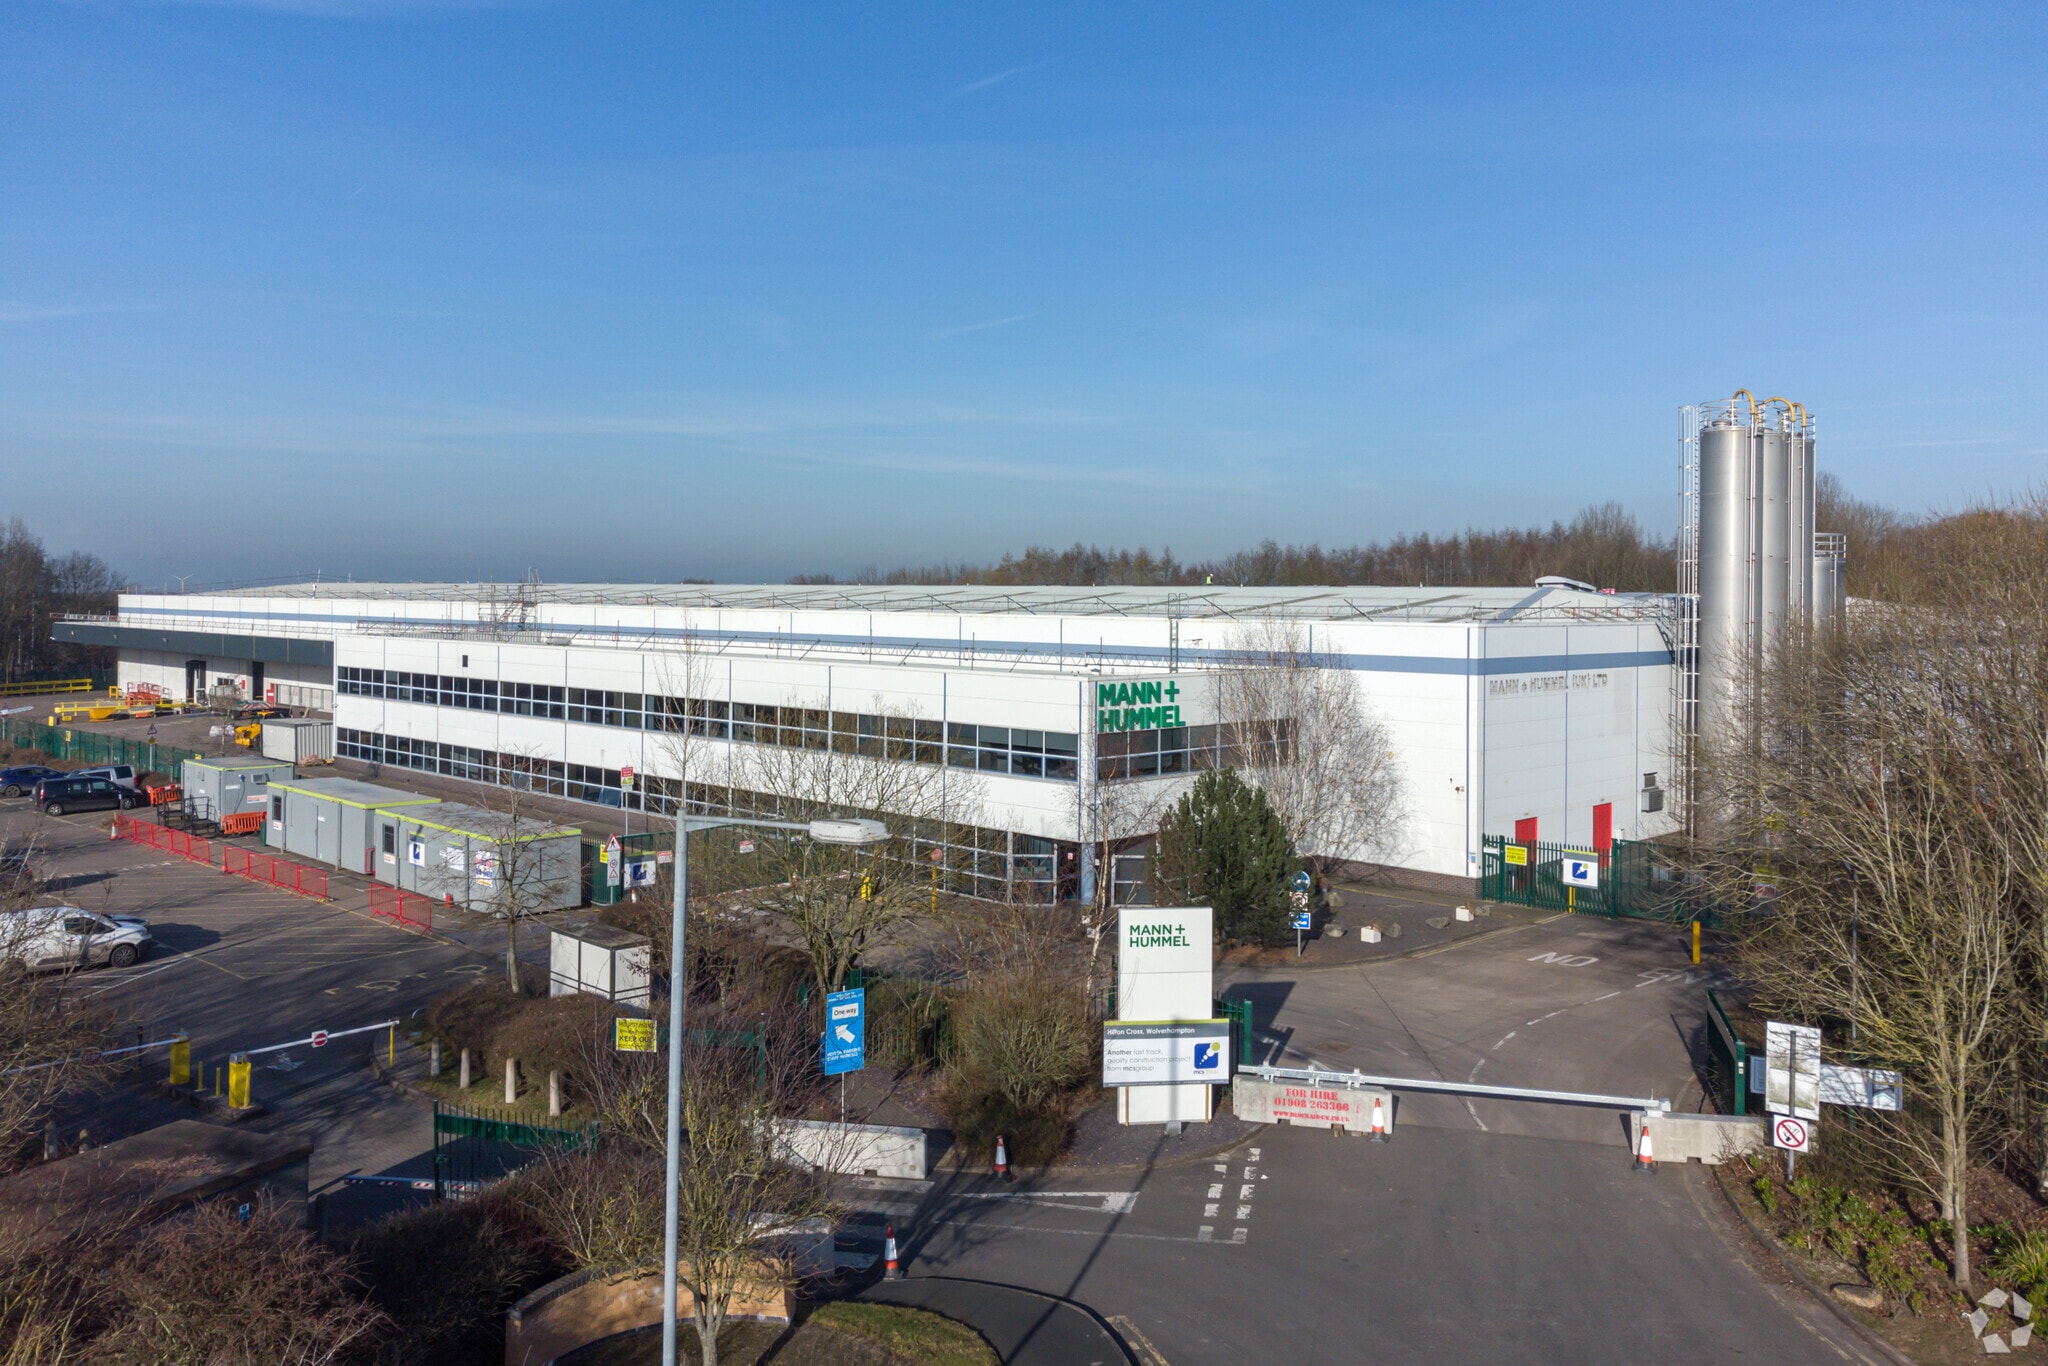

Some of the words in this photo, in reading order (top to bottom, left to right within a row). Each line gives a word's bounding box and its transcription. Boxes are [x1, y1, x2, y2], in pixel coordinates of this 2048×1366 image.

[1099, 704, 1186, 732] HUMMEL
[1129, 935, 1190, 948] HUMMEL
[833, 1008, 845, 1016] One
[846, 1007, 857, 1015] way
[1146, 1027, 1195, 1036] Wolverhampton
[1129, 1056, 1168, 1064] construction
[1285, 1088, 1307, 1099] FOR
[1310, 1090, 1339, 1101] HIRE
[1274, 1097, 1307, 1109] 01908
